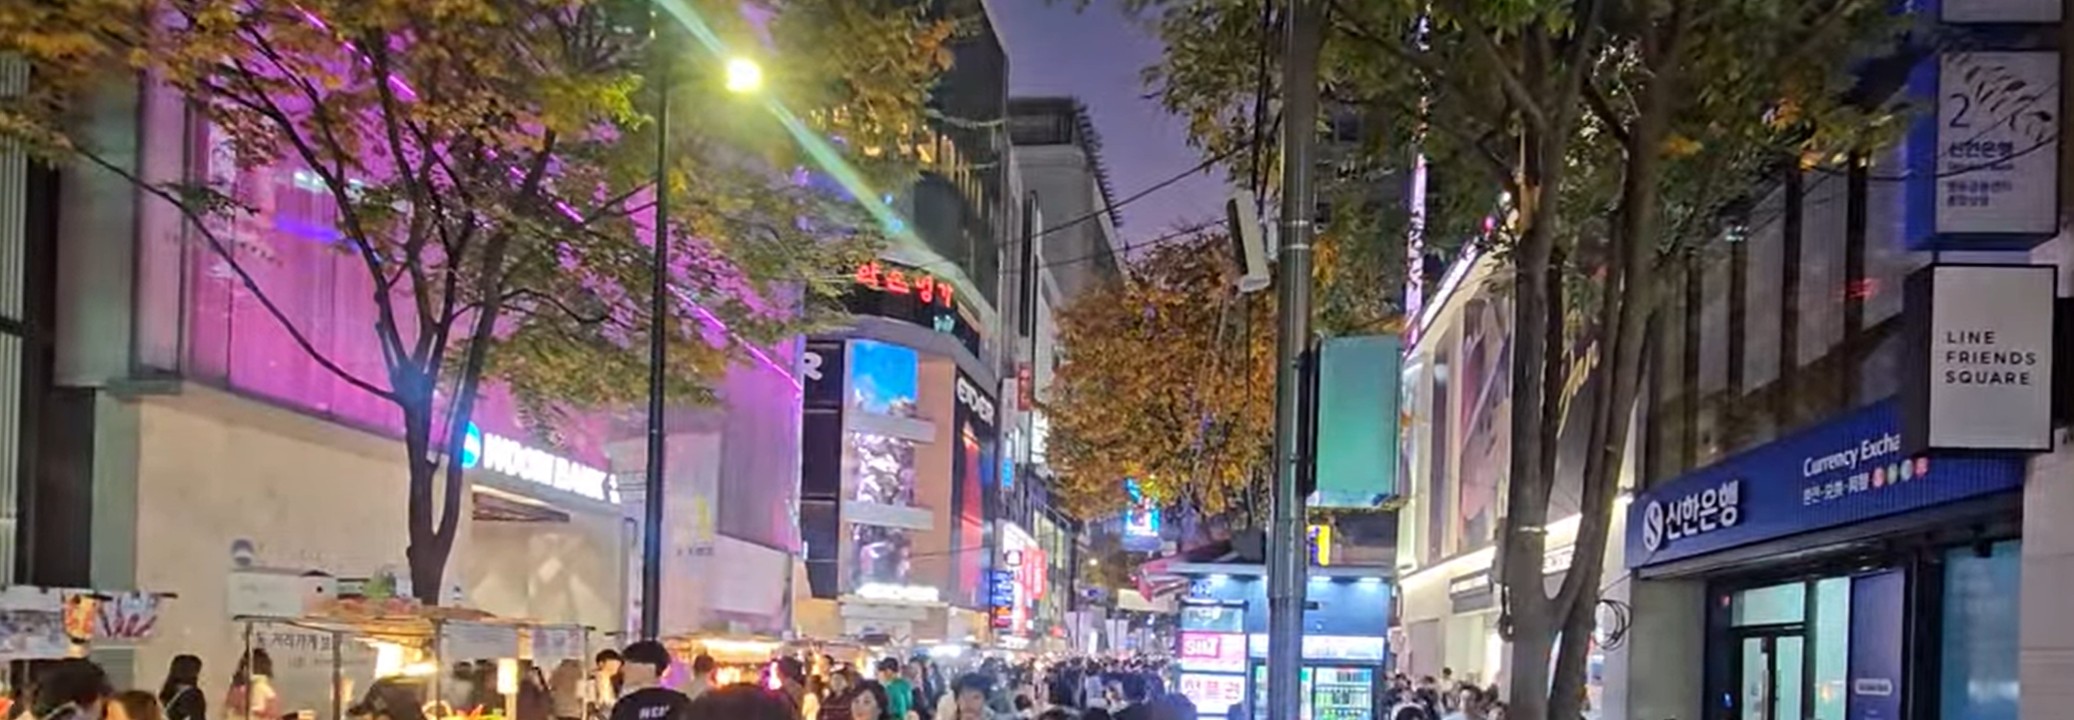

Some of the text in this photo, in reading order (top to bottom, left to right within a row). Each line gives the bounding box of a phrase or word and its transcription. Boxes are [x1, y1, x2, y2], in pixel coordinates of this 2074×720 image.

[1950, 92, 1970, 128] 2
[1947, 331, 1996, 344] LINE
[1946, 351, 2037, 365] FRIENDS
[1945, 370, 2032, 385] SQUARE
[1803, 447, 1859, 478] Currency
[1665, 479, 1739, 541] 신한은행
